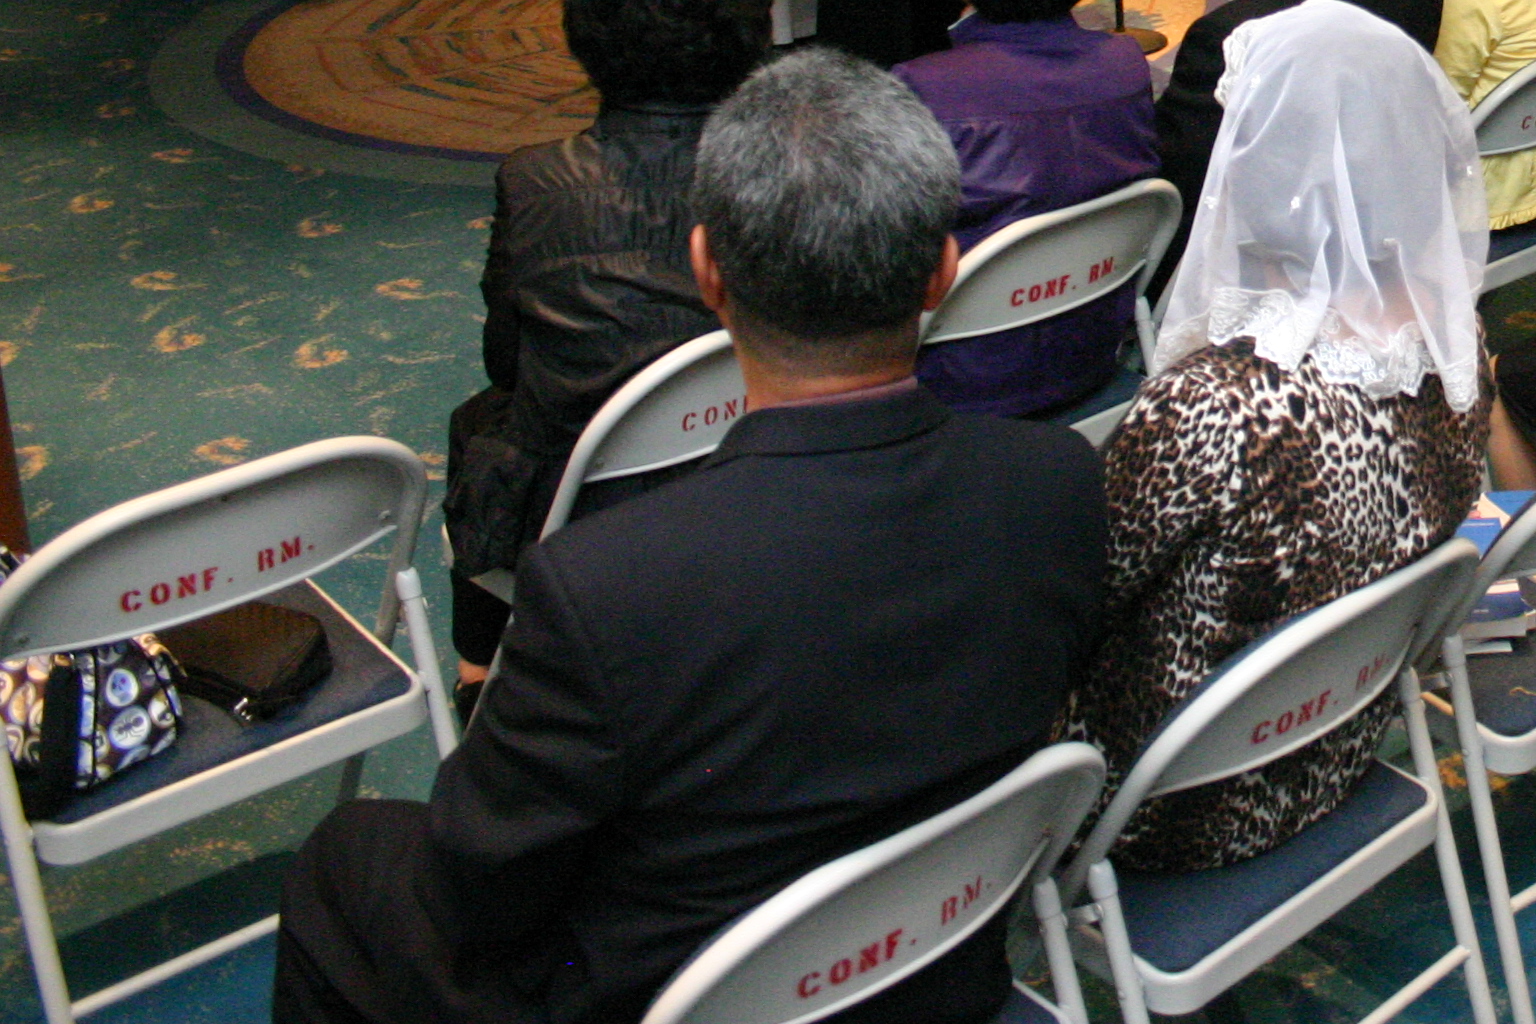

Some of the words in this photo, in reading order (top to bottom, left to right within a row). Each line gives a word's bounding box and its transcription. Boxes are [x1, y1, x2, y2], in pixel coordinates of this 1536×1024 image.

[1010, 274, 1077, 307] CONF.
[119, 565, 235, 613] CONF.
[257, 534, 316, 573] RM.
[1250, 688, 1339, 745] CONF.
[796, 927, 918, 999] CONF.
[941, 874, 992, 927] RM.
